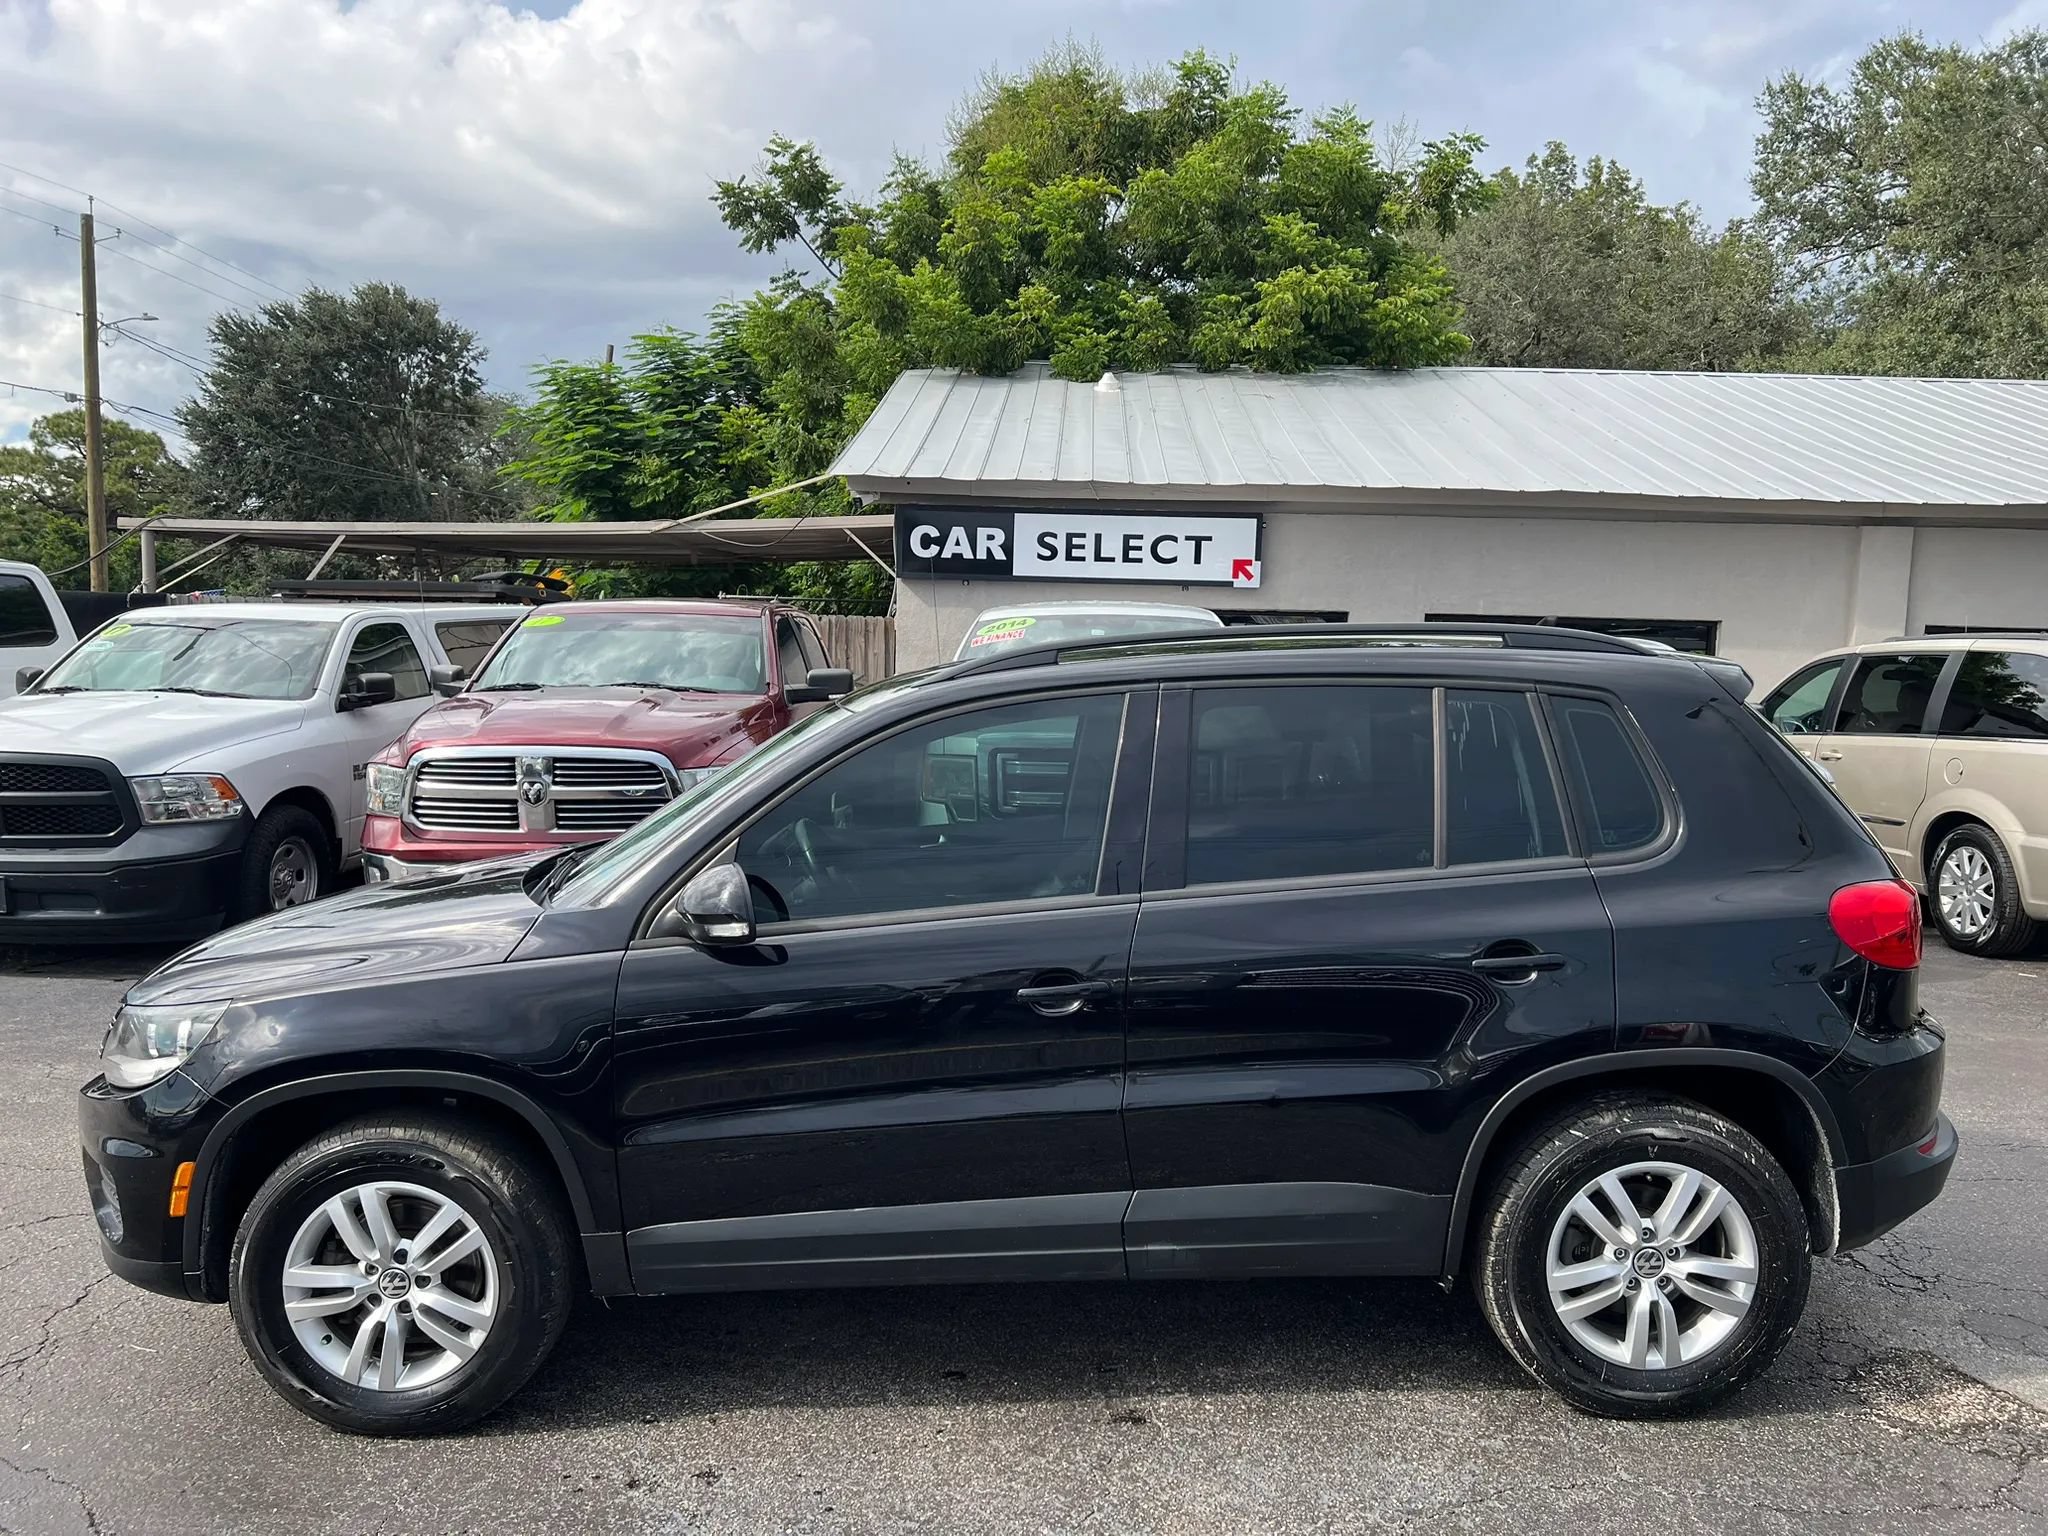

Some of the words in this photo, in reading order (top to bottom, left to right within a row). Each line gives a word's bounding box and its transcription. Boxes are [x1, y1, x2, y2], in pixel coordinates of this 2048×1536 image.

[909, 524, 1007, 561] CAR
[1036, 531, 1213, 565] SELECT
[985, 619, 1027, 633] 2014
[972, 634, 985, 646] WE
[987, 630, 1024, 641] FINANCE
